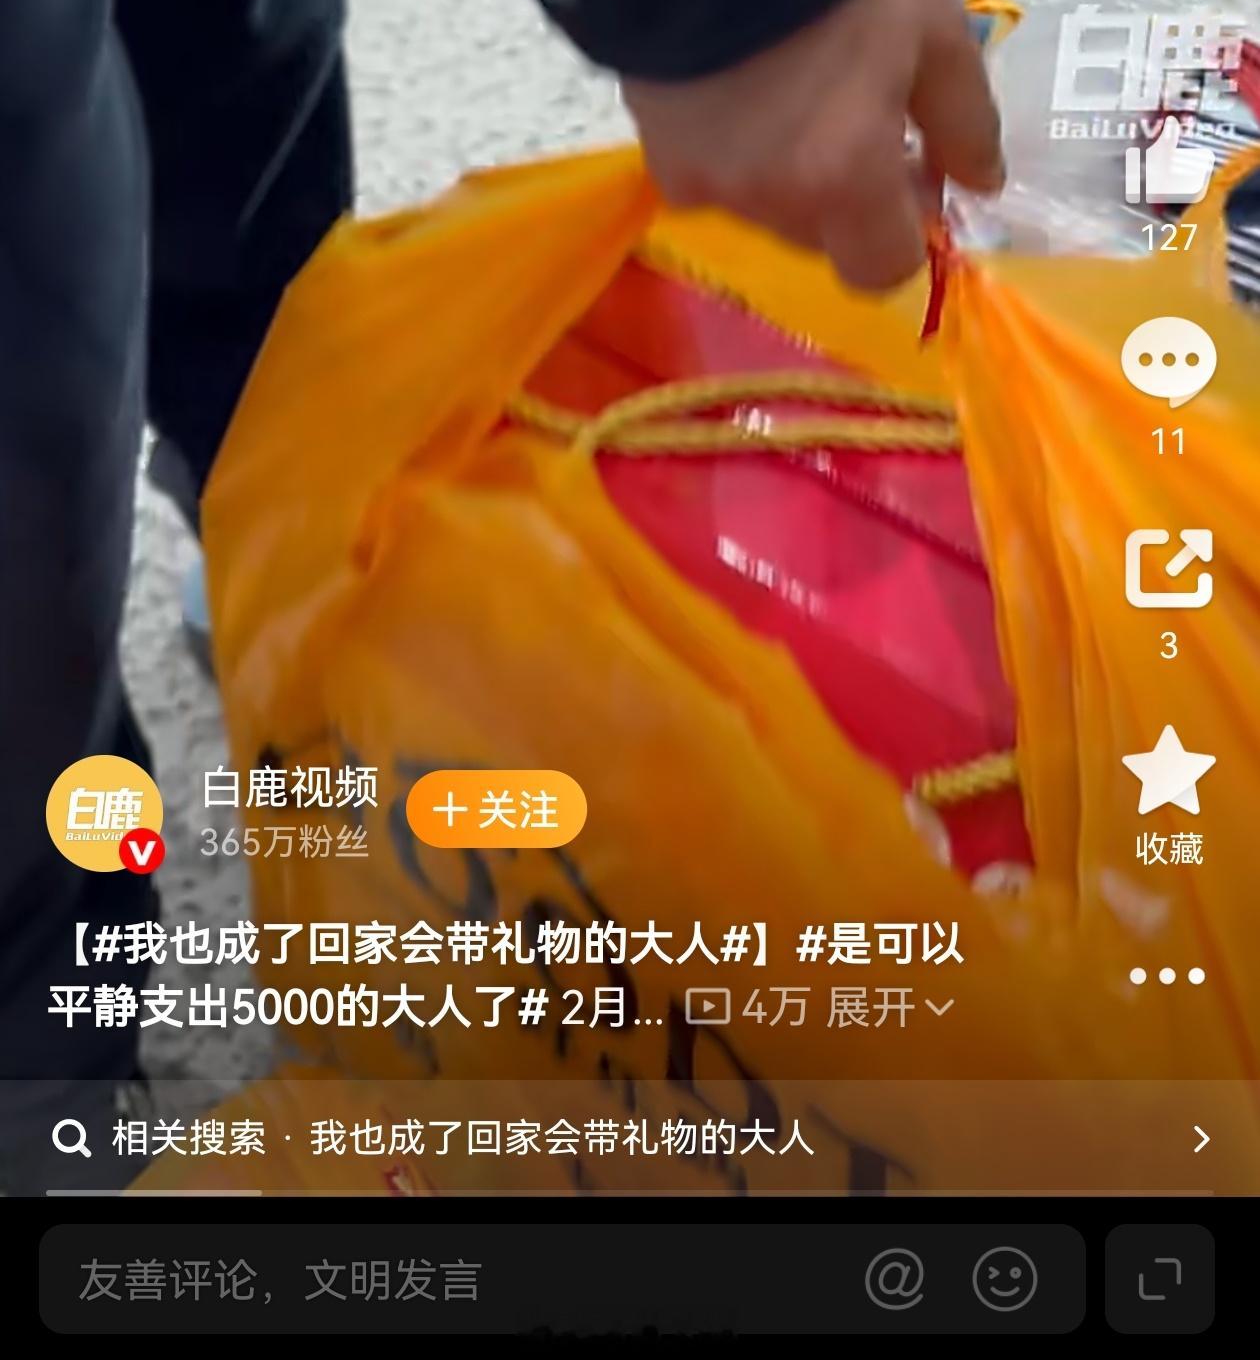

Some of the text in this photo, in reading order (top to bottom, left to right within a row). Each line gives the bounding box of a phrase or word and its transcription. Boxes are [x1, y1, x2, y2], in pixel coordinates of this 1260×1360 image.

[1141, 223, 1197, 251] 127
[1151, 428, 1185, 455] 11
[1159, 633, 1179, 659] 3
[203, 765, 379, 809] 白鹿视频
[66, 787, 144, 830] 白鹿
[200, 825, 369, 859] 365万粉丝
[1135, 832, 1204, 866] 收藏
[47, 983, 549, 1028] 平静支出5000的大人了#
[742, 988, 811, 1027] 4万
[826, 987, 915, 1028] 展开
[112, 1119, 266, 1156] 相关搜索
[310, 1119, 815, 1156] 我也成了回家会带礼物的大人
[78, 1258, 482, 1304] 友善评论，文明发言
